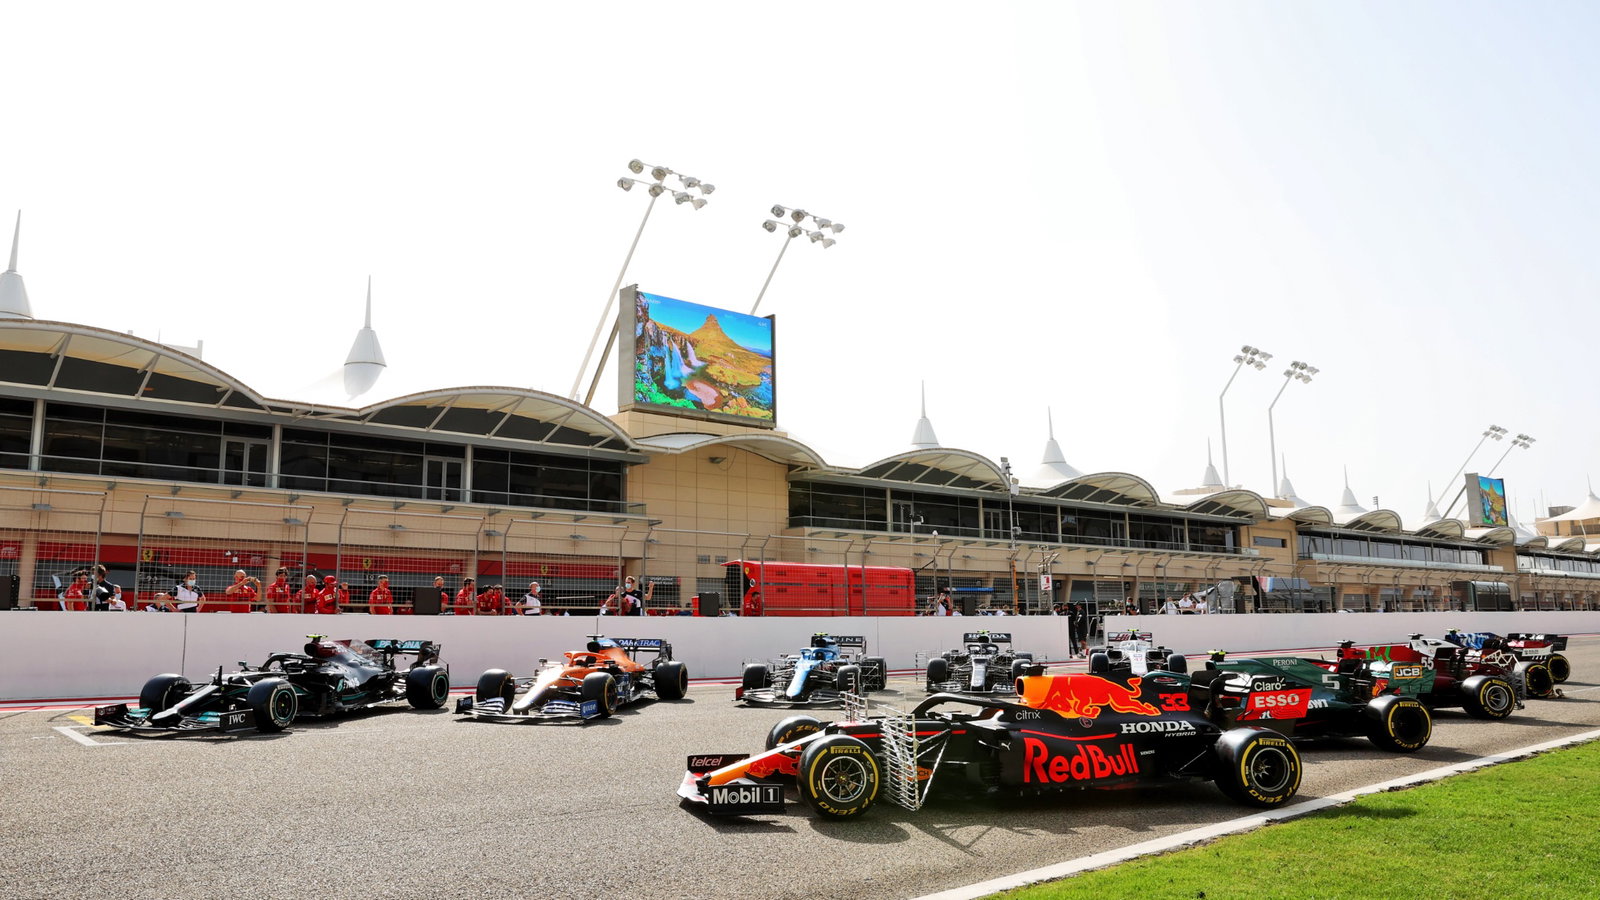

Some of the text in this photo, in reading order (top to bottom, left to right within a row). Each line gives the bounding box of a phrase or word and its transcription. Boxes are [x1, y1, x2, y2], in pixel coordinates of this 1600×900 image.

[1273, 658, 1298, 667] PERONI
[1421, 656, 1435, 670] 55
[1396, 668, 1421, 677] JCB
[1254, 681, 1282, 692] Claro
[1322, 674, 1340, 690] 5
[1159, 693, 1191, 711] 33
[1254, 693, 1300, 708] ESSO
[229, 713, 246, 725] IWC
[1015, 709, 1041, 721] citrix
[796, 724, 821, 733] ZER
[1120, 720, 1196, 734] HONDA
[830, 745, 861, 755] PIRELLI
[691, 756, 722, 767] telcel
[712, 787, 760, 805] Mobil
[818, 801, 858, 816] ZERO
